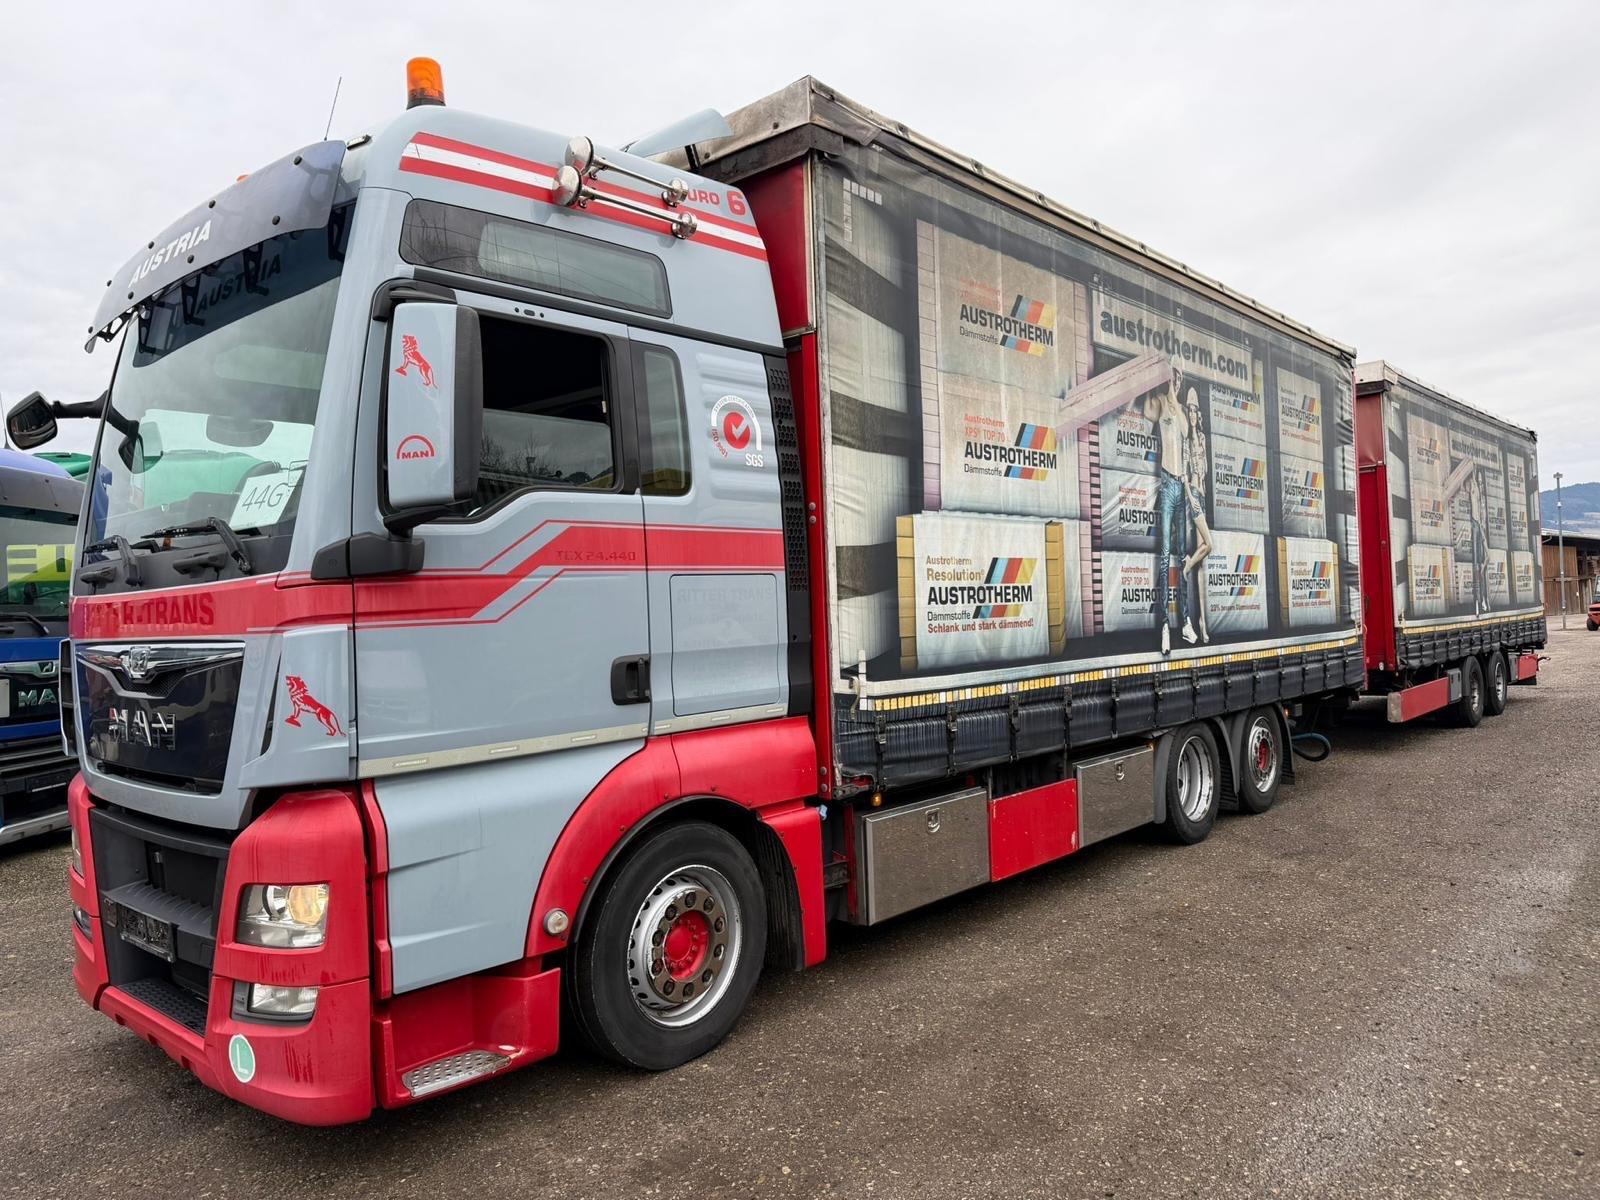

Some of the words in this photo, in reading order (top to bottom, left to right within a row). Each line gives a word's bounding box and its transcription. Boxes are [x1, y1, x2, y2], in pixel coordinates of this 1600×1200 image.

[688, 189, 720, 206] URO
[726, 190, 746, 216] 6
[128, 219, 212, 288] AUSTRIA
[196, 253, 281, 313] AUSTIA
[960, 303, 1053, 346] AUSTROTHERM
[1100, 310, 1248, 381] austrotherm.com
[964, 412, 1004, 428] Austrotherm
[1116, 430, 1157, 451] AUSTROT
[401, 450, 429, 460] MAN
[745, 453, 764, 468] SGS
[964, 441, 1057, 470] AUSTROTHERM
[1216, 472, 1264, 491] AUSTROTHERM
[1119, 508, 1161, 526] AUSTROT
[586, 551, 636, 561] 24.440
[926, 556, 973, 566] Austrotherm
[1208, 574, 1258, 587] AUSTROTHERM
[1291, 578, 1331, 591] AUSTROTHERM
[928, 585, 1033, 606] AUSTROTHERM
[928, 621, 960, 634] Schlank
[961, 621, 976, 632] und
[978, 619, 997, 631] stark
[998, 618, 1034, 629] dämmend!
[18, 688, 58, 707] MA
[235, 1042, 249, 1074] L
